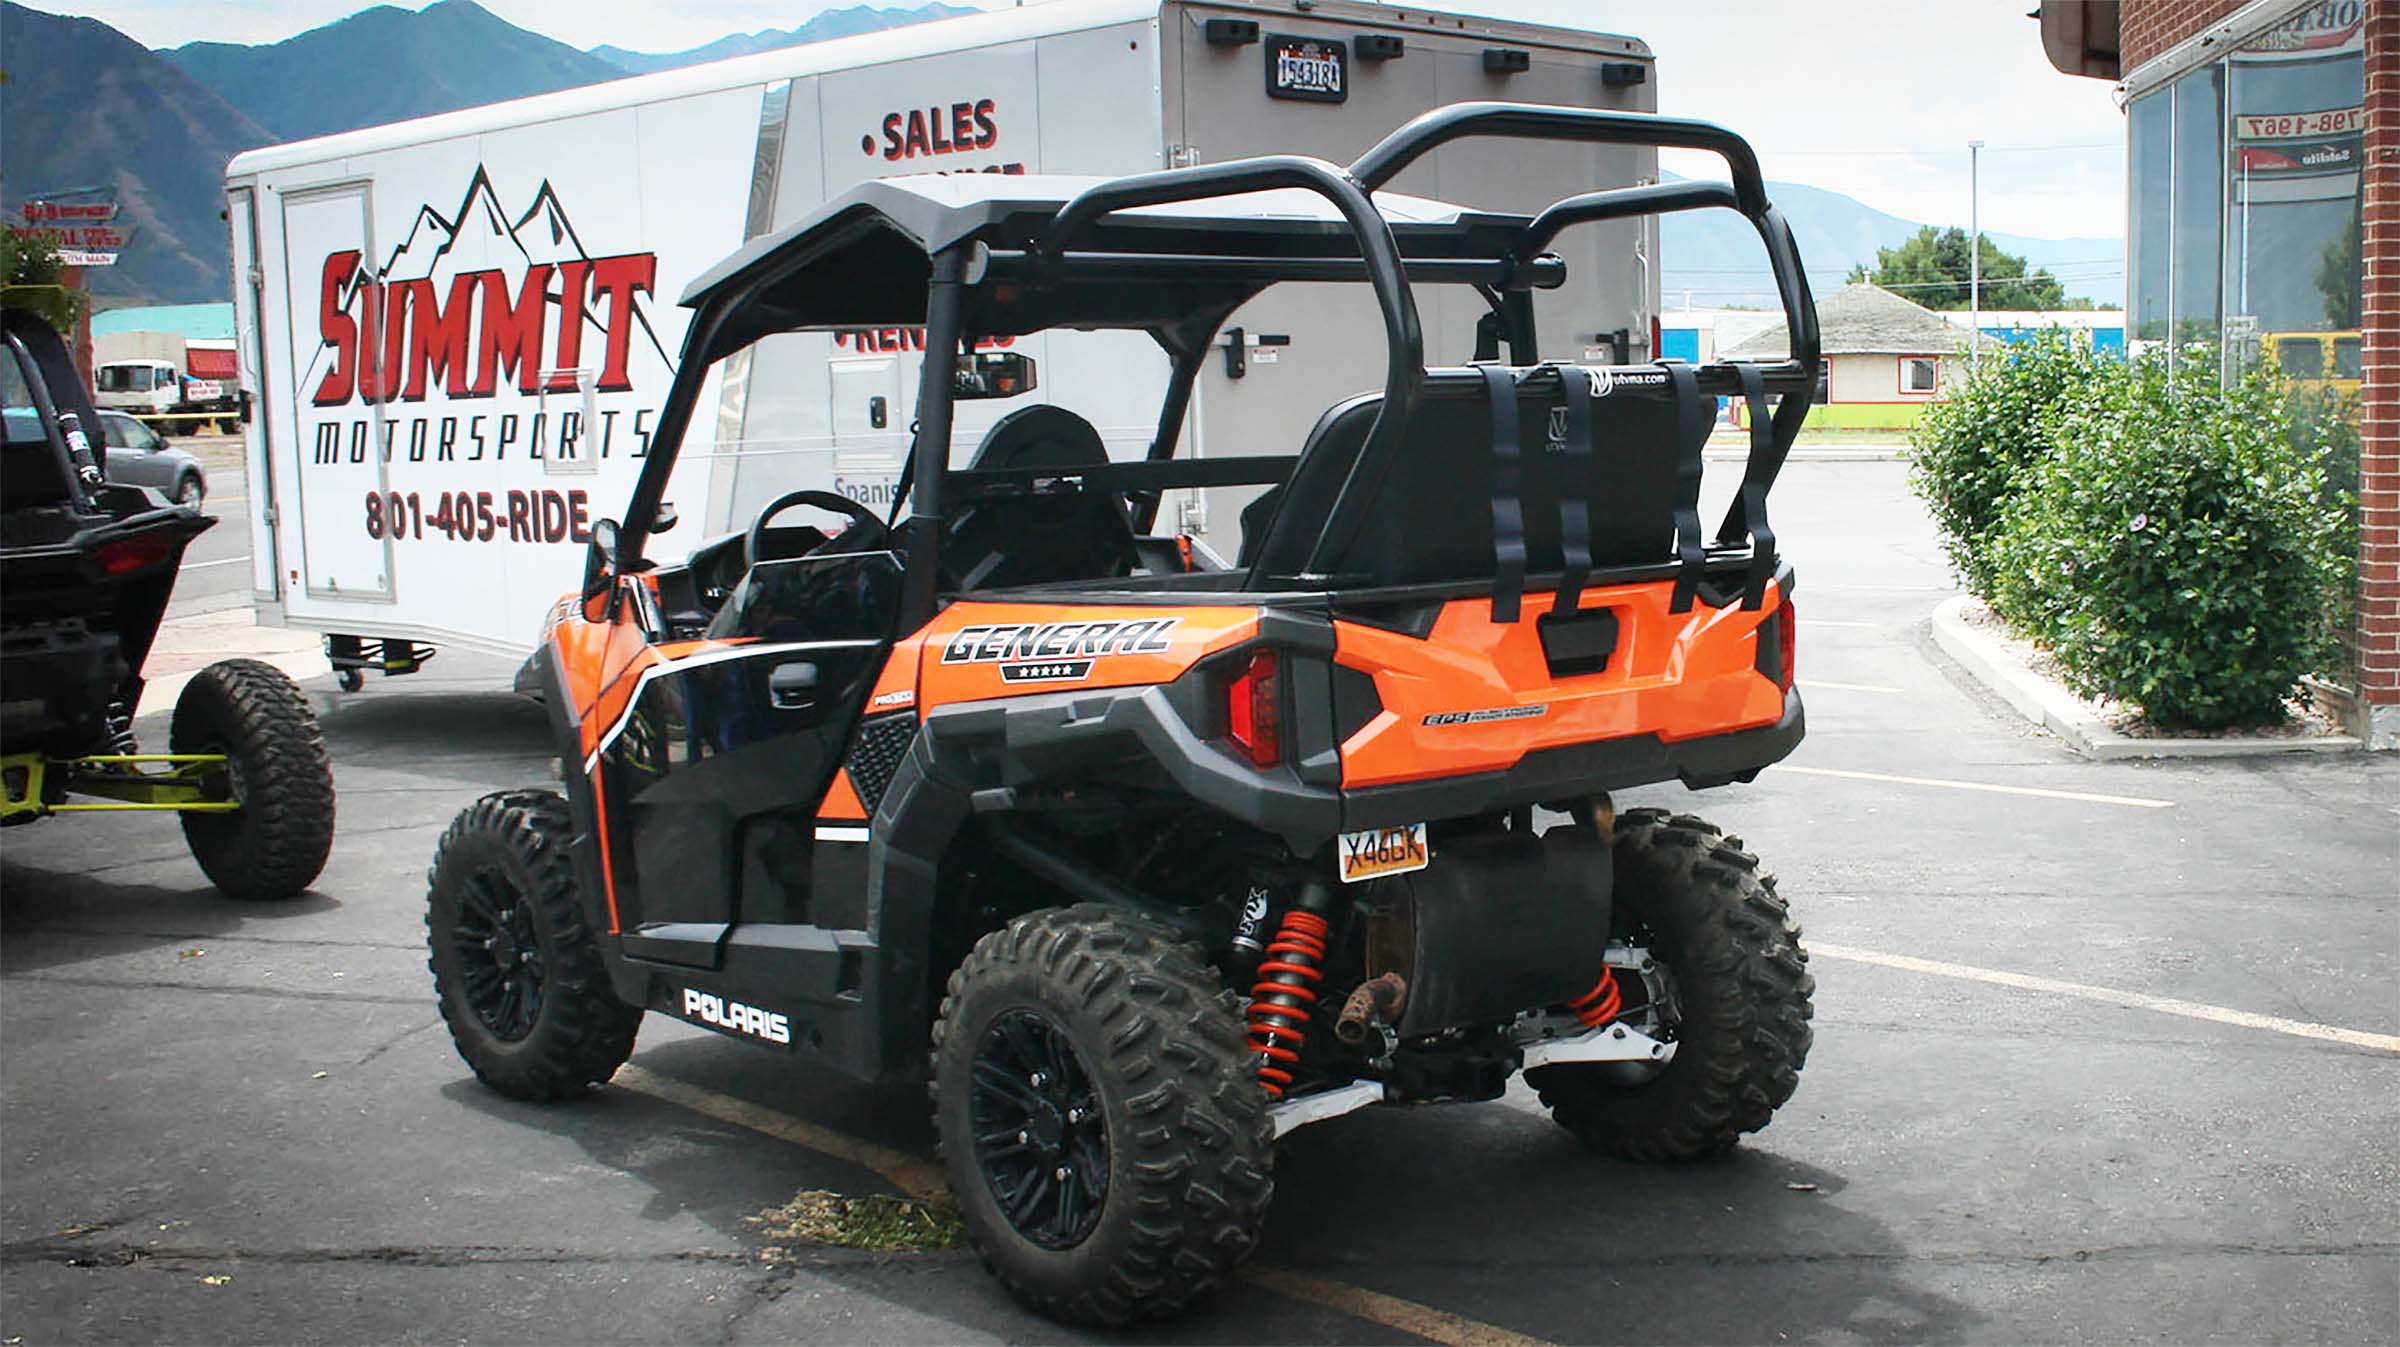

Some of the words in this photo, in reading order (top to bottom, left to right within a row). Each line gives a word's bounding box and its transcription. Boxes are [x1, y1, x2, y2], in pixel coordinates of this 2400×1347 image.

[883, 99, 998, 161] SALES
[311, 249, 657, 407] SUMMIT
[315, 409, 654, 464] MOTORSPORTS
[366, 489, 594, 544] 801-405-RIDE
[940, 617, 1184, 665] GENERAL
[683, 987, 790, 1044] POLARIS
